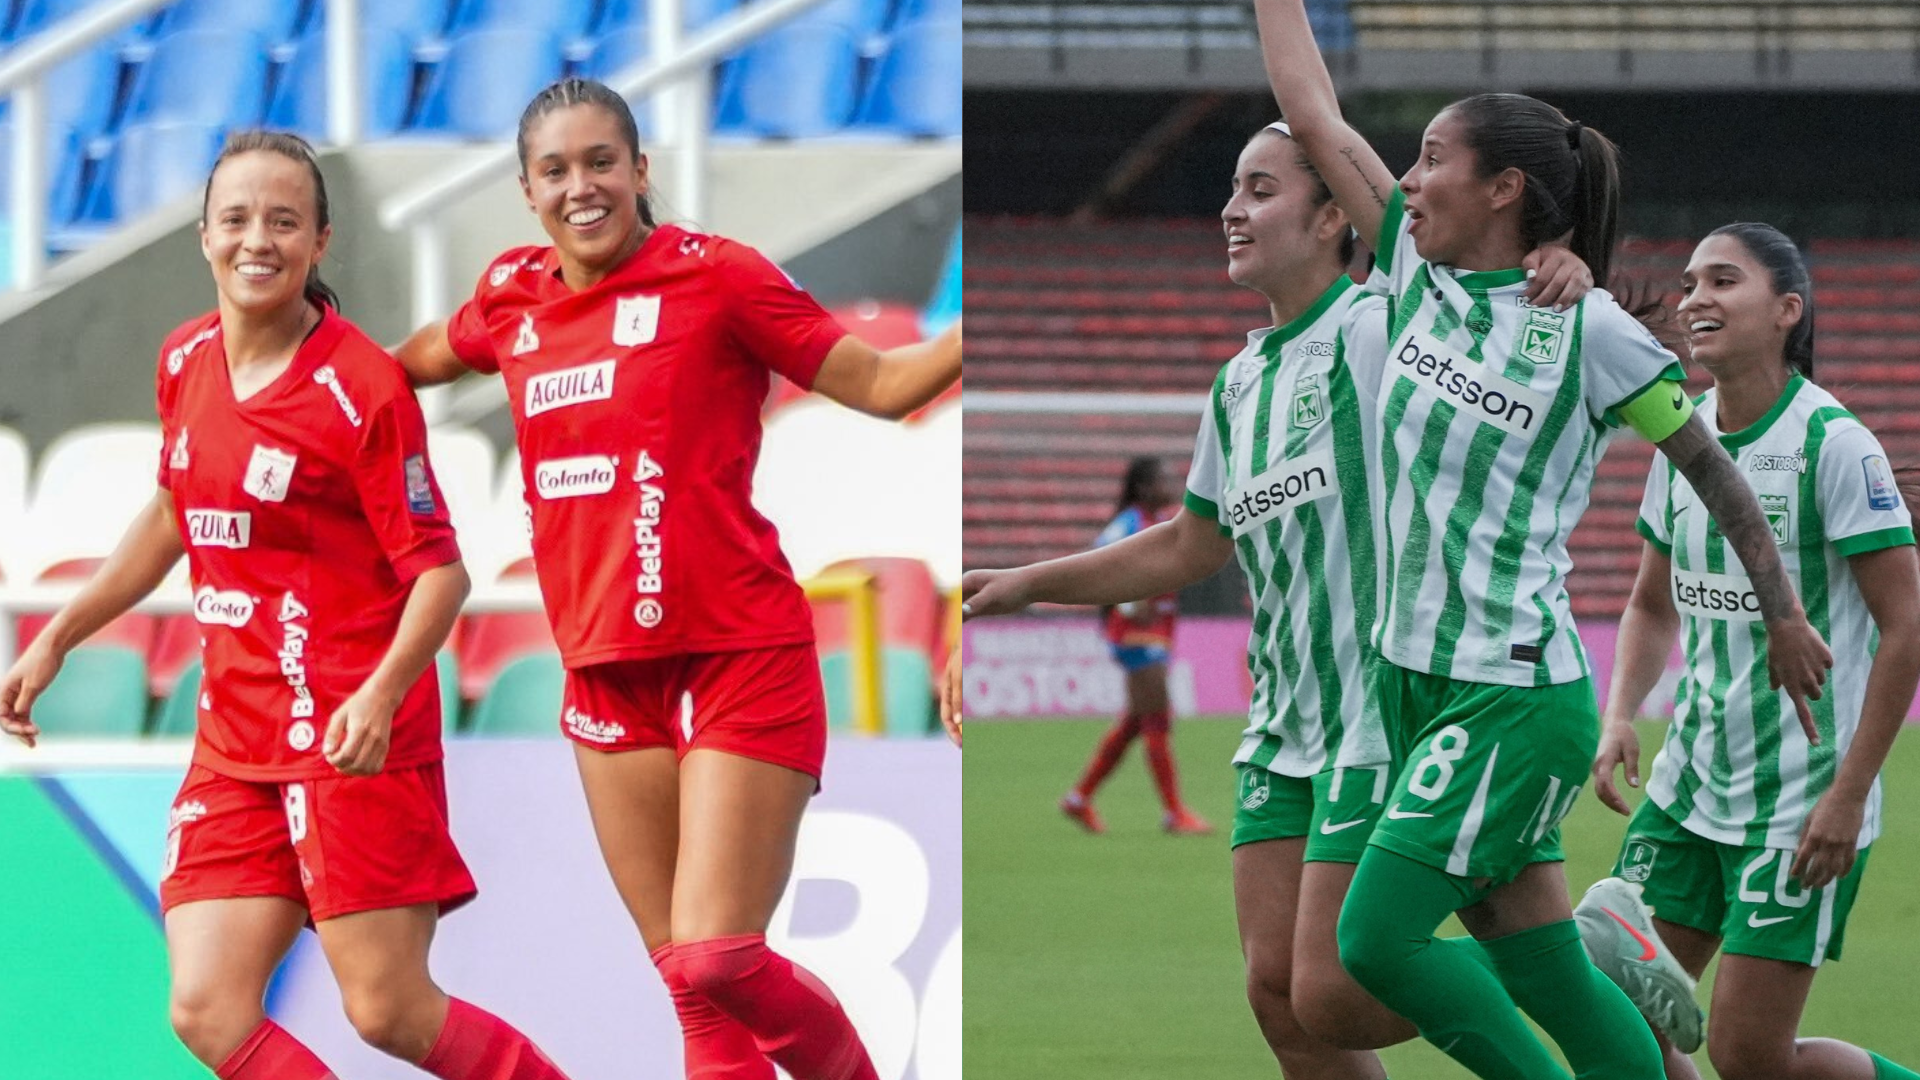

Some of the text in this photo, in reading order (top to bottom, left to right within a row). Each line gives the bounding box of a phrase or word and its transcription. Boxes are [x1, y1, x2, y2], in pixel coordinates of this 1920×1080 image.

[530, 368, 605, 411] AGUILA
[1397, 335, 1534, 430] betsson
[538, 467, 611, 490] Colanta
[1228, 467, 1327, 526] etsson
[634, 484, 664, 594] BetPlay
[1408, 725, 1470, 801] 8
[1738, 848, 1813, 909] 20
